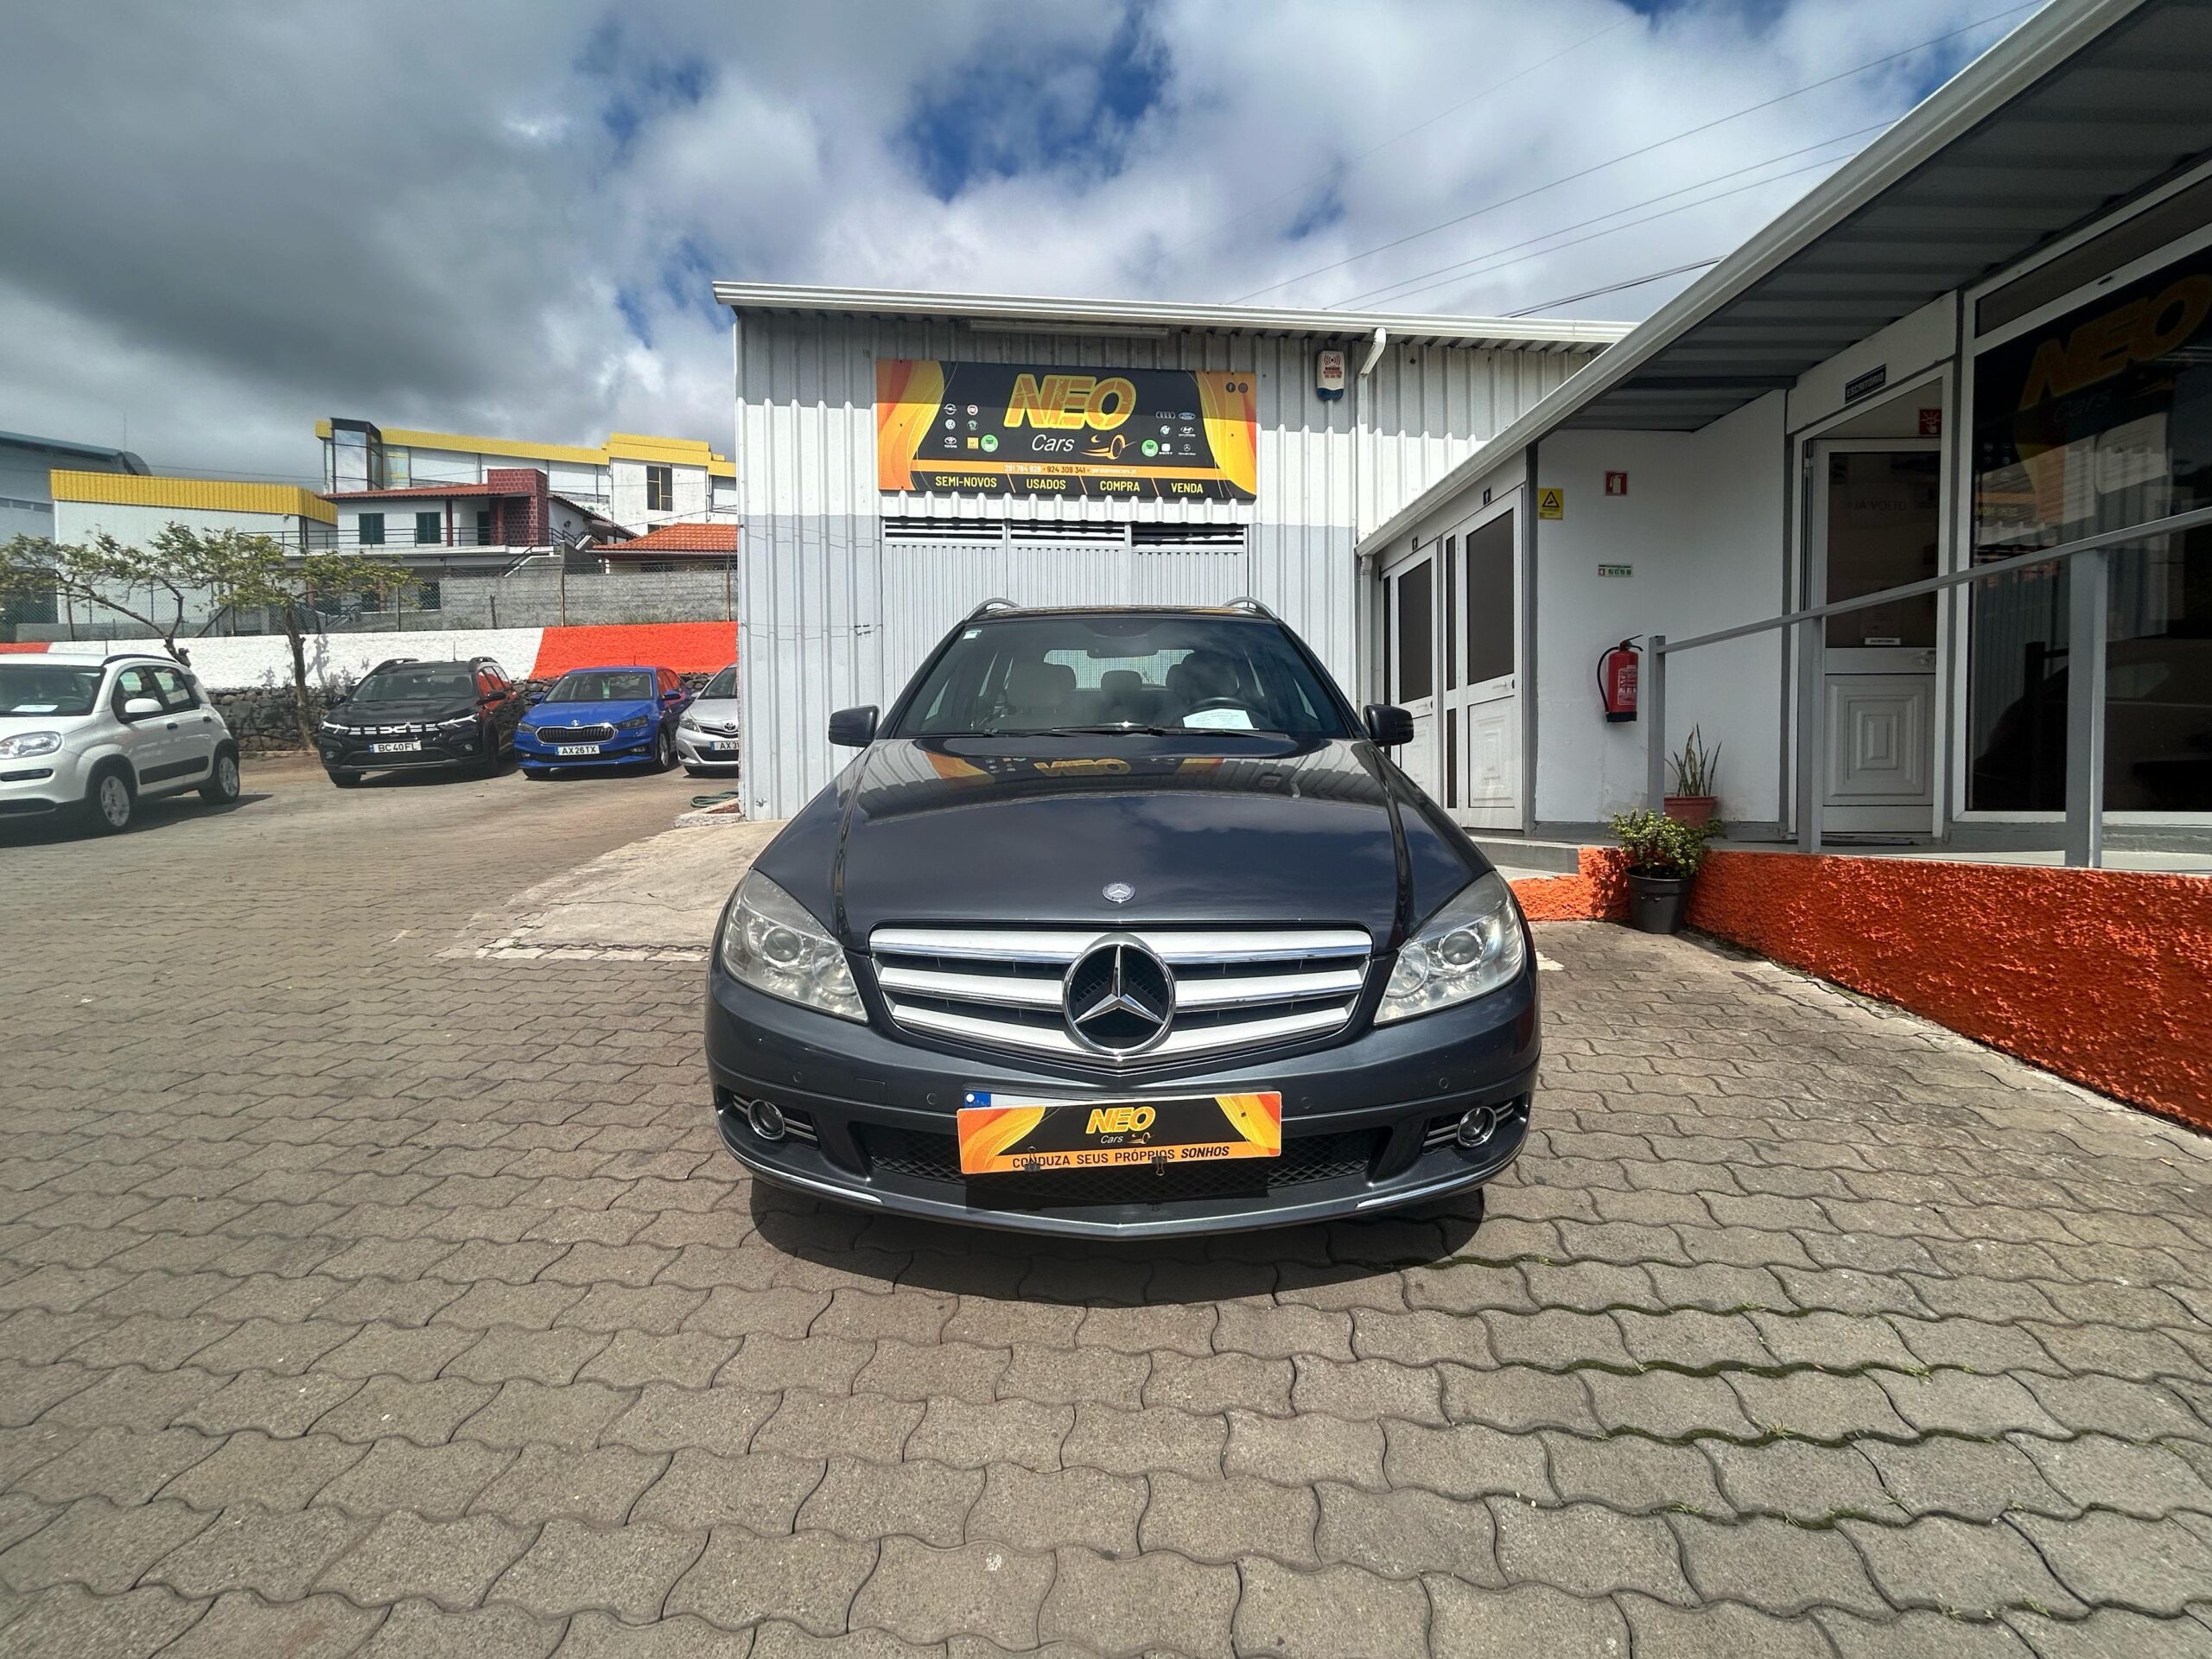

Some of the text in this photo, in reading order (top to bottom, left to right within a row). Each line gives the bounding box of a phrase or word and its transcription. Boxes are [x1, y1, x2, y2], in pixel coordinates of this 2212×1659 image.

[1003, 373, 1136, 430] NEO
[1031, 434, 1075, 452] Cars
[935, 476, 1204, 493] SEMI-NOVOS USADOS COMPRA VENDA
[1085, 1106, 1156, 1134] NEO
[1100, 1135, 1123, 1144] Cars
[1013, 1155, 1071, 1168] CONDUZA
[1077, 1153, 1109, 1165] SEUS
[1181, 1146, 1230, 1159] SONHOS
